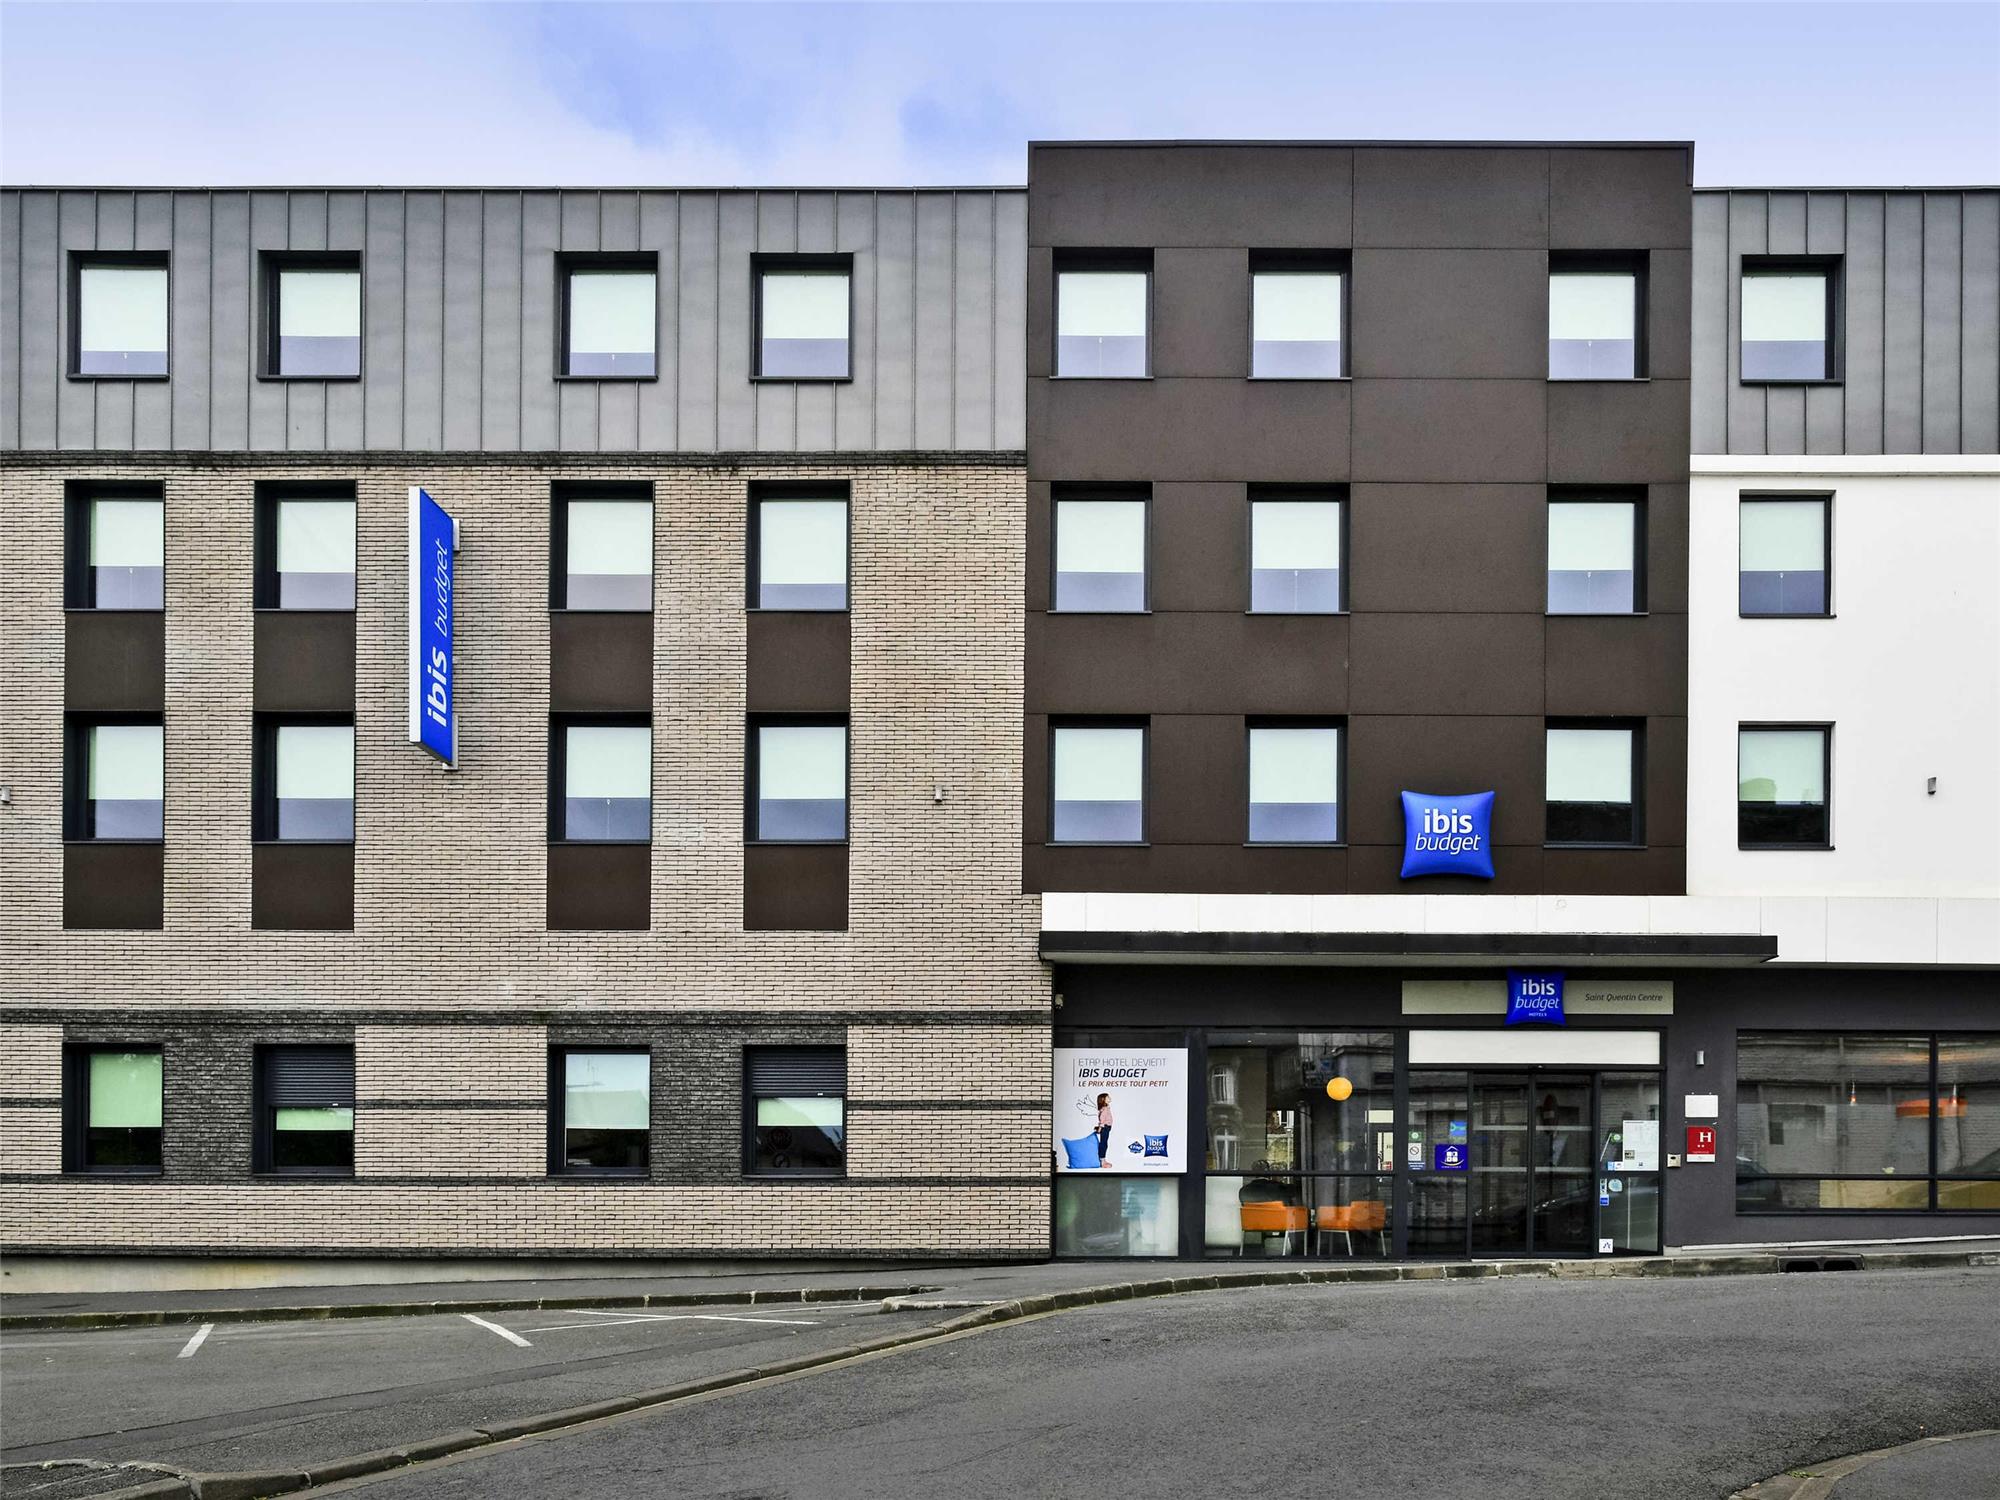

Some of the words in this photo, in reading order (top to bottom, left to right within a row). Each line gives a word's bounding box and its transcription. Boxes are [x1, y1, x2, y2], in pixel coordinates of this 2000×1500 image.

[433, 537, 451, 638] budget
[427, 646, 447, 727] ibis
[1424, 808, 1473, 834] ibis
[1415, 832, 1481, 855] budget
[1522, 979, 1555, 996] ibis
[1515, 996, 1559, 1012] budget
[1585, 993, 1604, 1002] Saint
[1606, 993, 1636, 1003] Quentin
[1638, 993, 1663, 1002] Centre
[1078, 1058, 1100, 1067] ETAP
[1103, 1058, 1129, 1067] HOTEL
[1131, 1058, 1166, 1067] DEVIENT
[1078, 1068, 1099, 1078] IBIS
[1103, 1068, 1147, 1078] BUDGET
[1149, 1138, 1163, 1146] ibis
[1699, 1132, 1712, 1143] H
